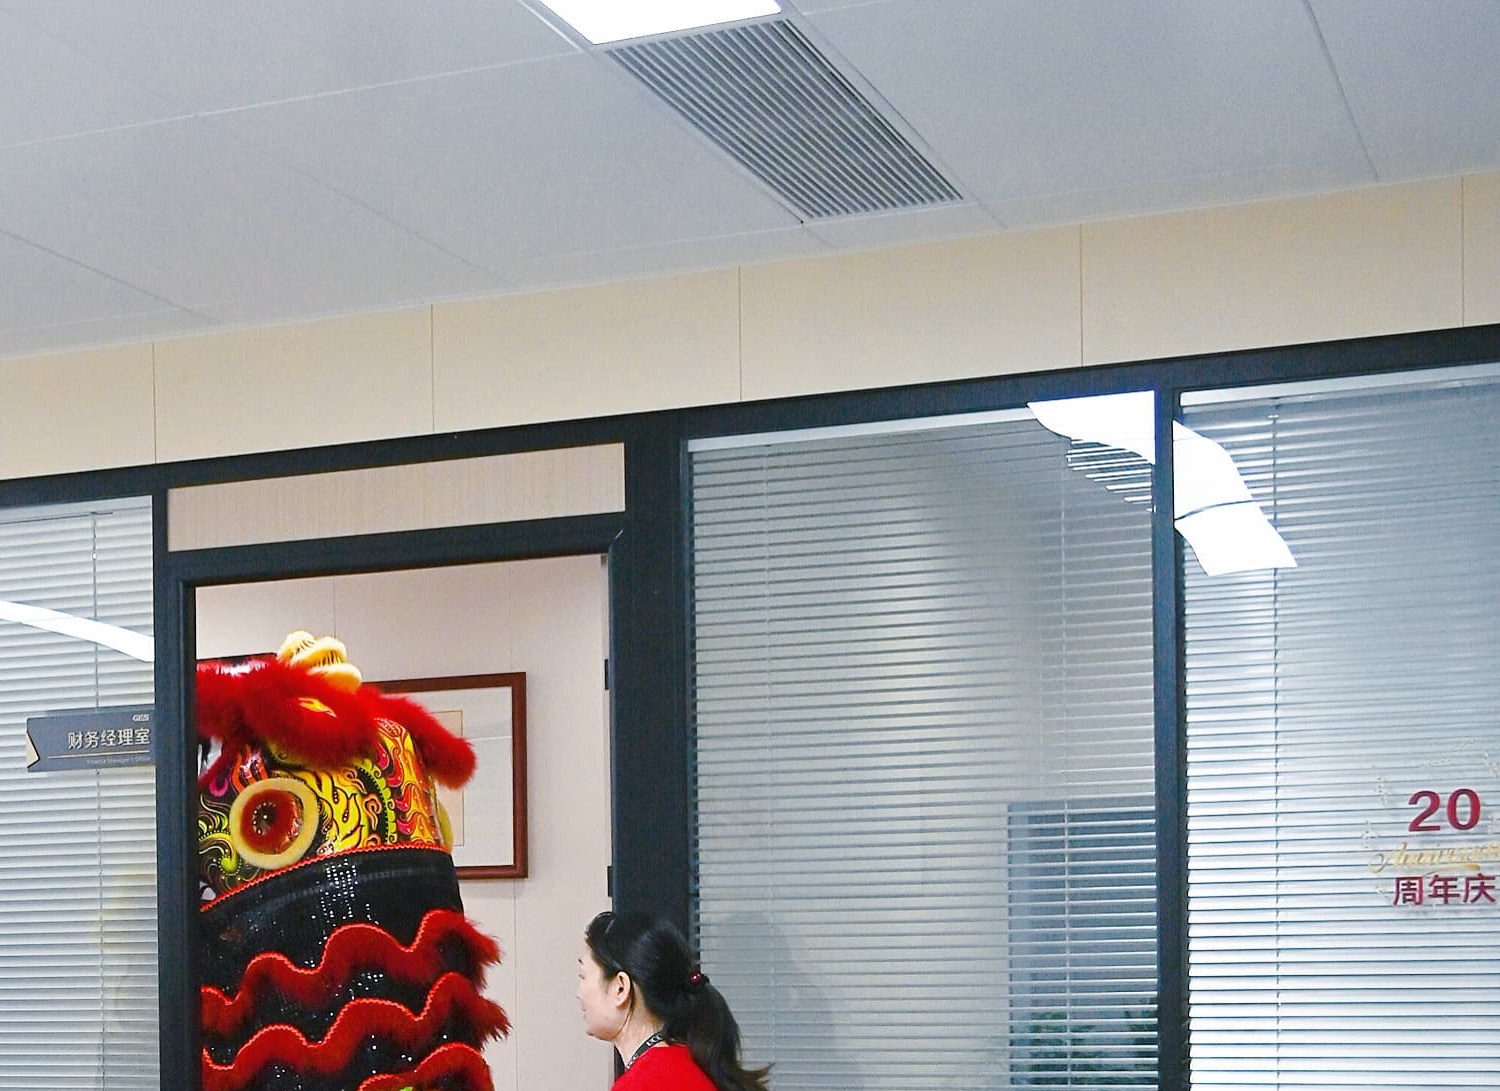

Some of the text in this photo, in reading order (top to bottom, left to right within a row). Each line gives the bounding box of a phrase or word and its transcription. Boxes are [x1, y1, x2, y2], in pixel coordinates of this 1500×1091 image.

[67, 728, 150, 750] 财务经理室
[1407, 787, 1482, 832] 20
[1393, 873, 1497, 907] 周年庆
